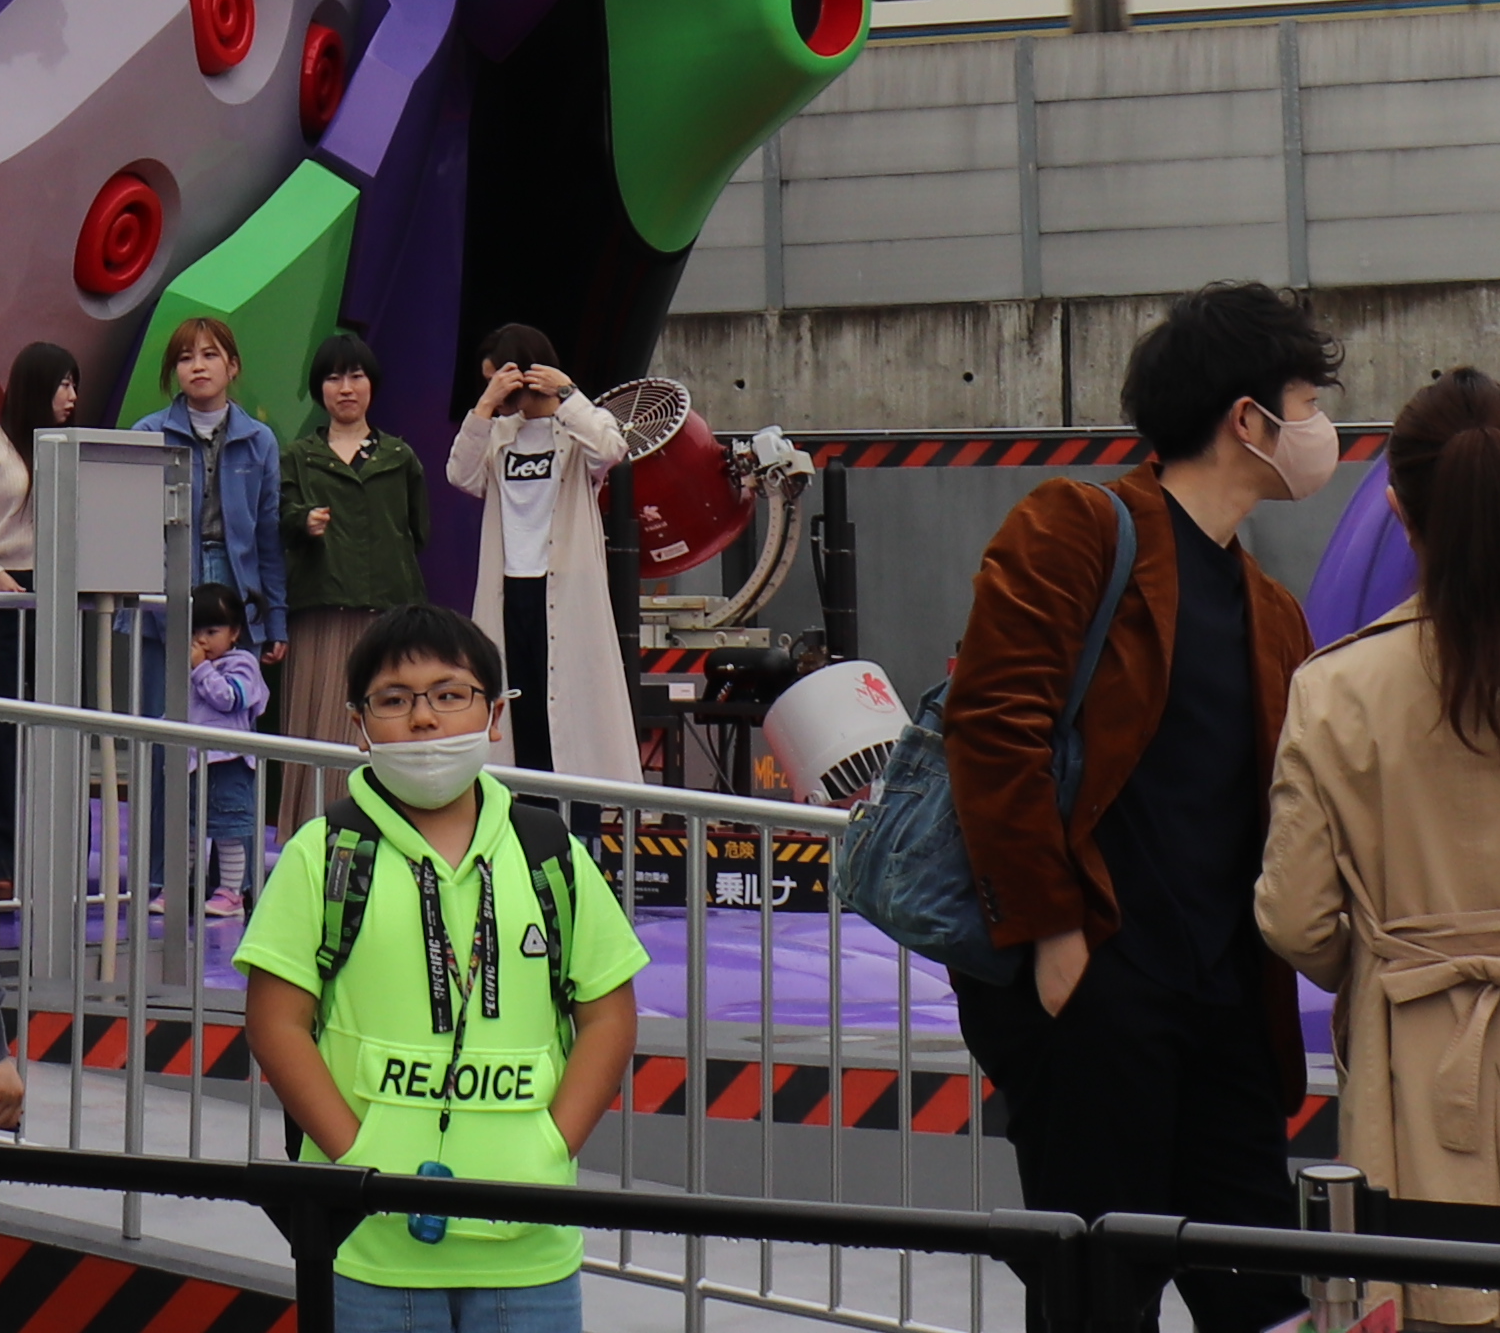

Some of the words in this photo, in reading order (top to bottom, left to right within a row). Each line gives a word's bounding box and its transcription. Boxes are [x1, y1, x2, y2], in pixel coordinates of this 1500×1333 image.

[507, 455, 550, 477] Lee
[724, 840, 755, 859] 危険
[379, 1058, 534, 1101] REJOICE
